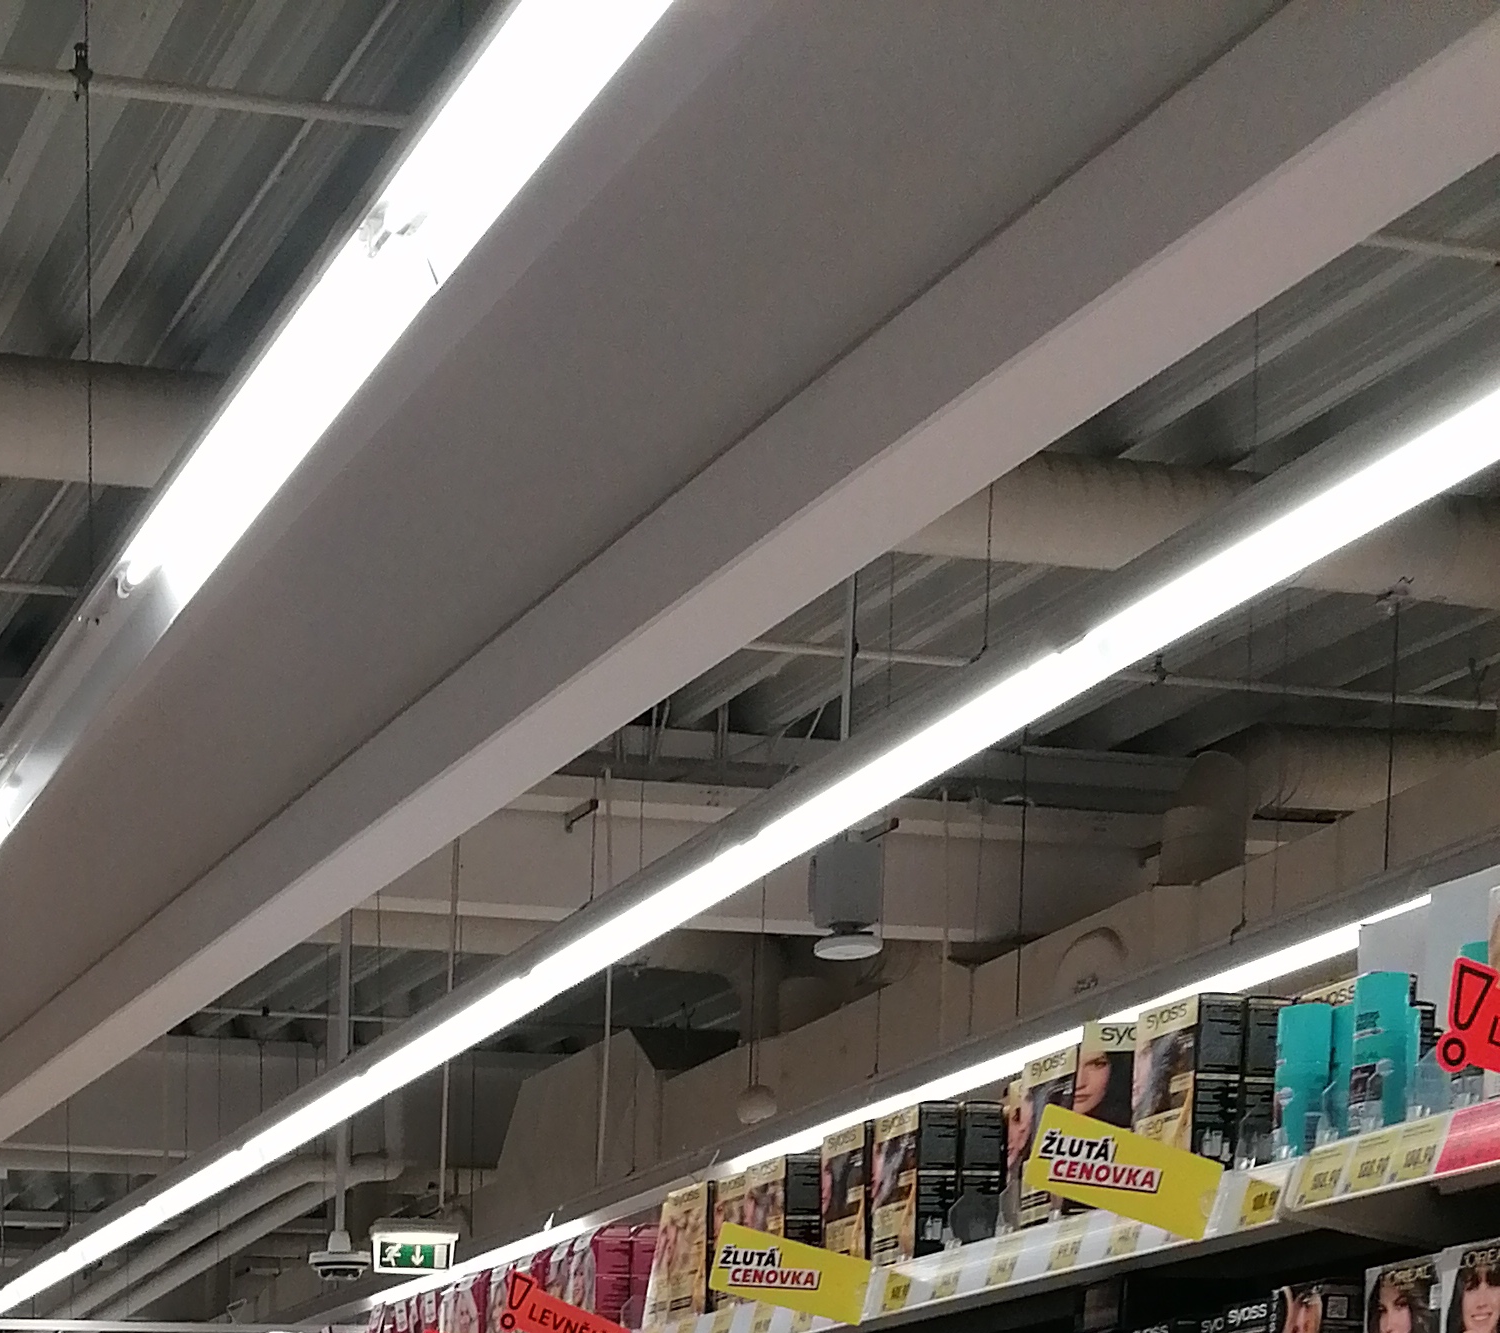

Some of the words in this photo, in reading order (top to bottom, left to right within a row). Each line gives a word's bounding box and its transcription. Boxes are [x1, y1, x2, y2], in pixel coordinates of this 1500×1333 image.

[1041, 1135, 1114, 1161] ŽLUTÁ
[1052, 1160, 1156, 1189] CENOVKA
[721, 1246, 780, 1268] ŽLUTÁ
[730, 1268, 818, 1288] CENOVKA
